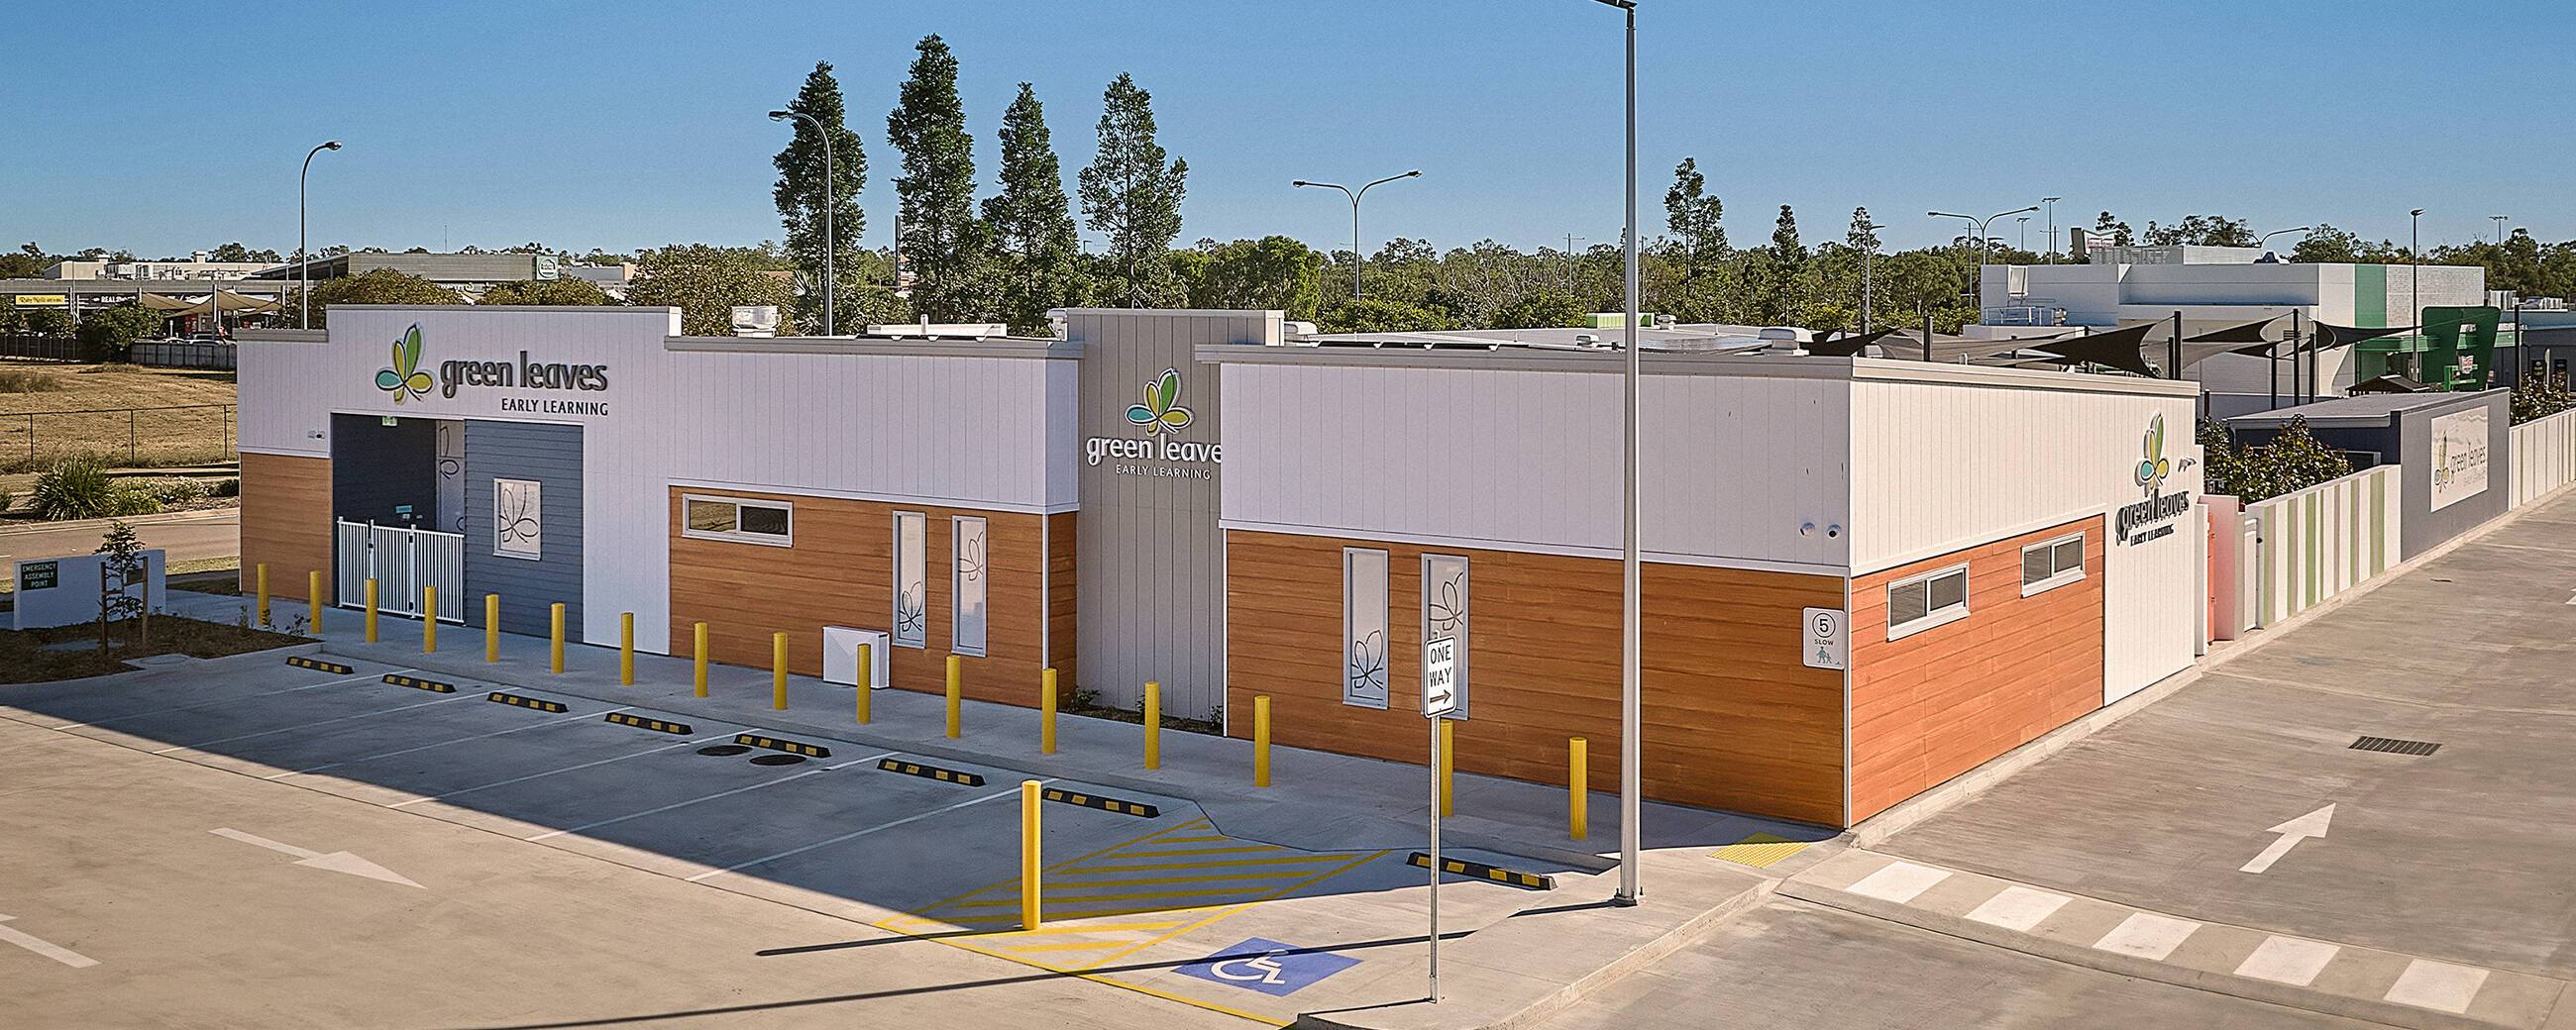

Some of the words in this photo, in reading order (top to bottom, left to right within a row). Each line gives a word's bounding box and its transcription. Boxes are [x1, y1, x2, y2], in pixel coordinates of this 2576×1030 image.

[440, 360, 513, 398] green
[520, 351, 607, 392] leaves
[501, 398, 539, 412] EARLY
[543, 400, 608, 416] LEARNING
[1086, 437, 1154, 466] green
[1160, 433, 1222, 464] leave
[1116, 464, 1149, 475] EARLY
[1154, 466, 1212, 480] LEARNING
[2116, 499, 2153, 543] green
[2153, 488, 2190, 519] leaves
[22, 564, 56, 572] EMERGENCY
[24, 571, 54, 580] ASSEMBLY
[1819, 618, 1829, 633] 5
[1430, 644, 1451, 665] ONE
[1429, 667, 1452, 687] WAY
